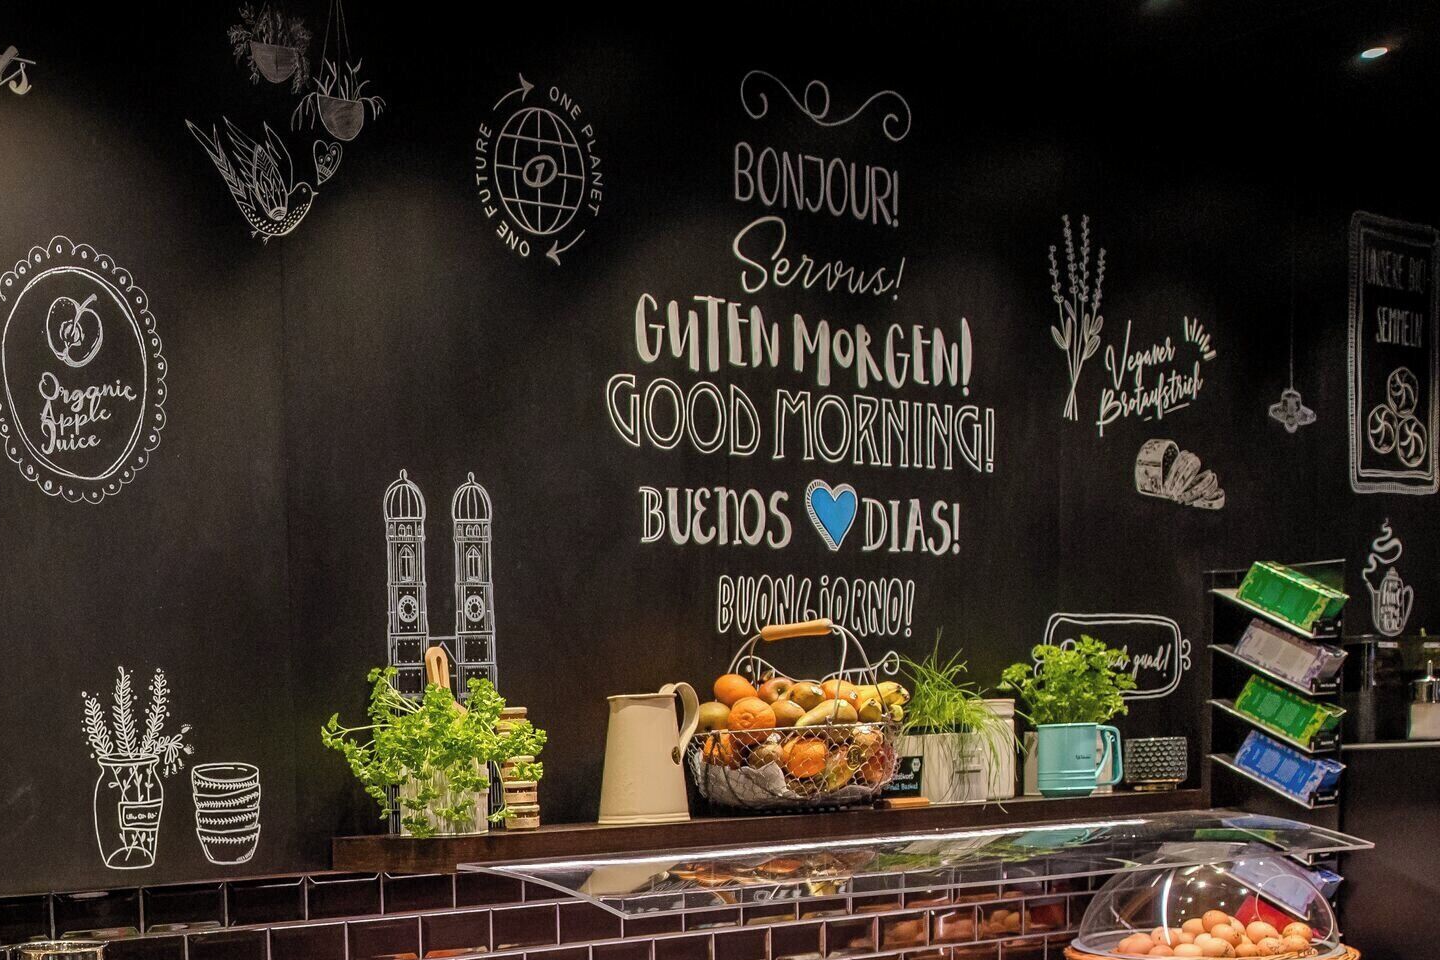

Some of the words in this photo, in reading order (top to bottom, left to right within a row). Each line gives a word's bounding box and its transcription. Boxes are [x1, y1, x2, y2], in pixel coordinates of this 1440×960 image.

[475, 123, 498, 218] FUTURE
[549, 86, 582, 120] ONE
[581, 124, 604, 217] PLANET
[734, 142, 900, 227] BONJOUR!
[496, 221, 530, 256] ONE
[732, 216, 905, 299] Servus!
[38, 371, 138, 412] Organic
[1105, 320, 1176, 390] Veganer
[40, 398, 112, 436] Apple
[607, 373, 761, 456] GOOD
[773, 389, 995, 473] MORNING!
[1096, 361, 1204, 438] Brotaufstrich
[41, 419, 101, 454] Juice
[639, 486, 793, 548] BUENOS
[862, 498, 961, 556] DIAS!
